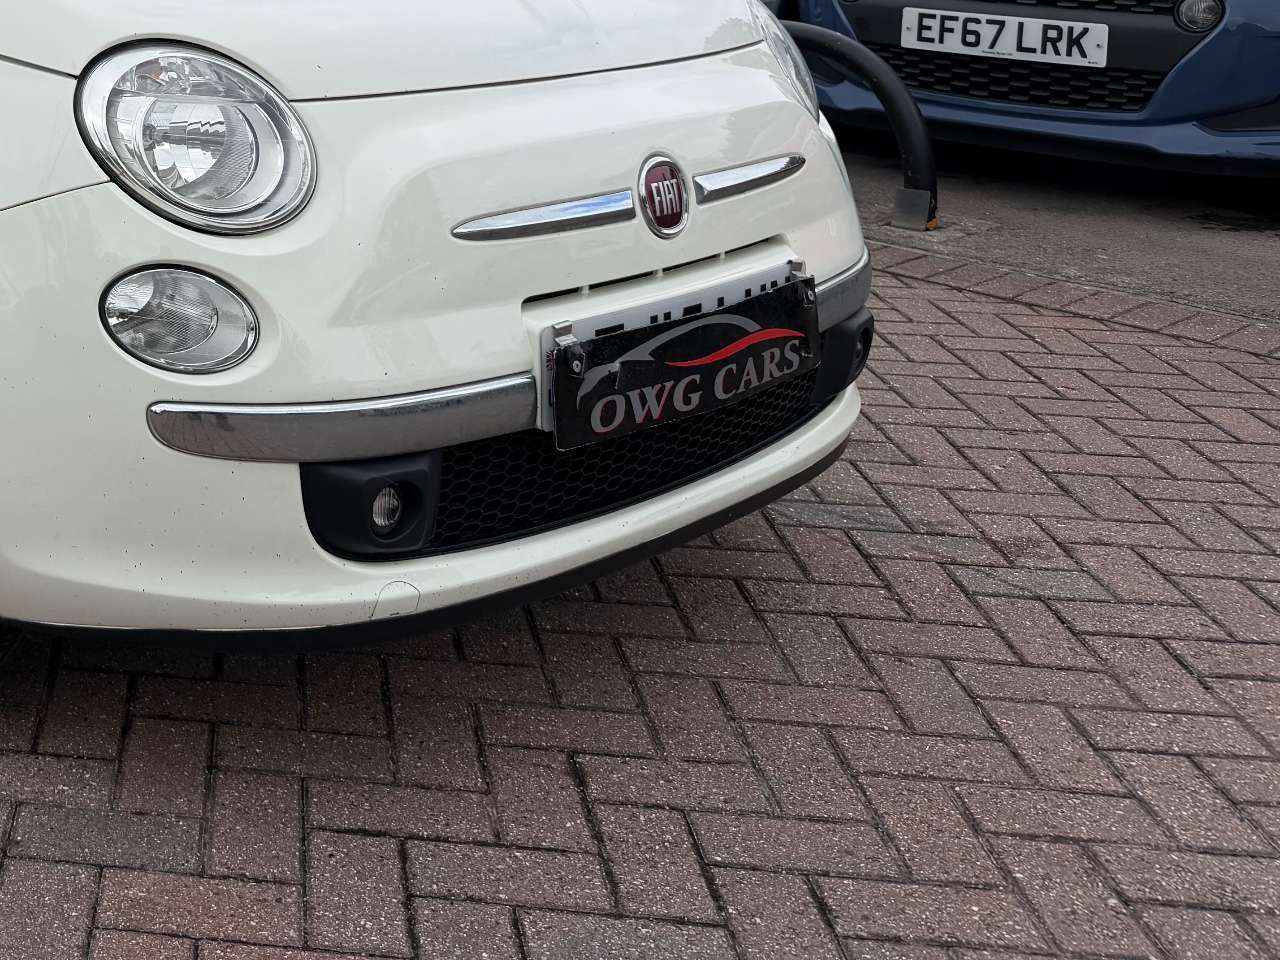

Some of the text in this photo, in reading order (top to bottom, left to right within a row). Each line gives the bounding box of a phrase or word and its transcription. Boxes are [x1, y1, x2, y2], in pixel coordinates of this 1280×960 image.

[916, 12, 1090, 59] EF67 LRK
[650, 178, 681, 217] FIAT
[590, 339, 800, 433] OWG CARS
